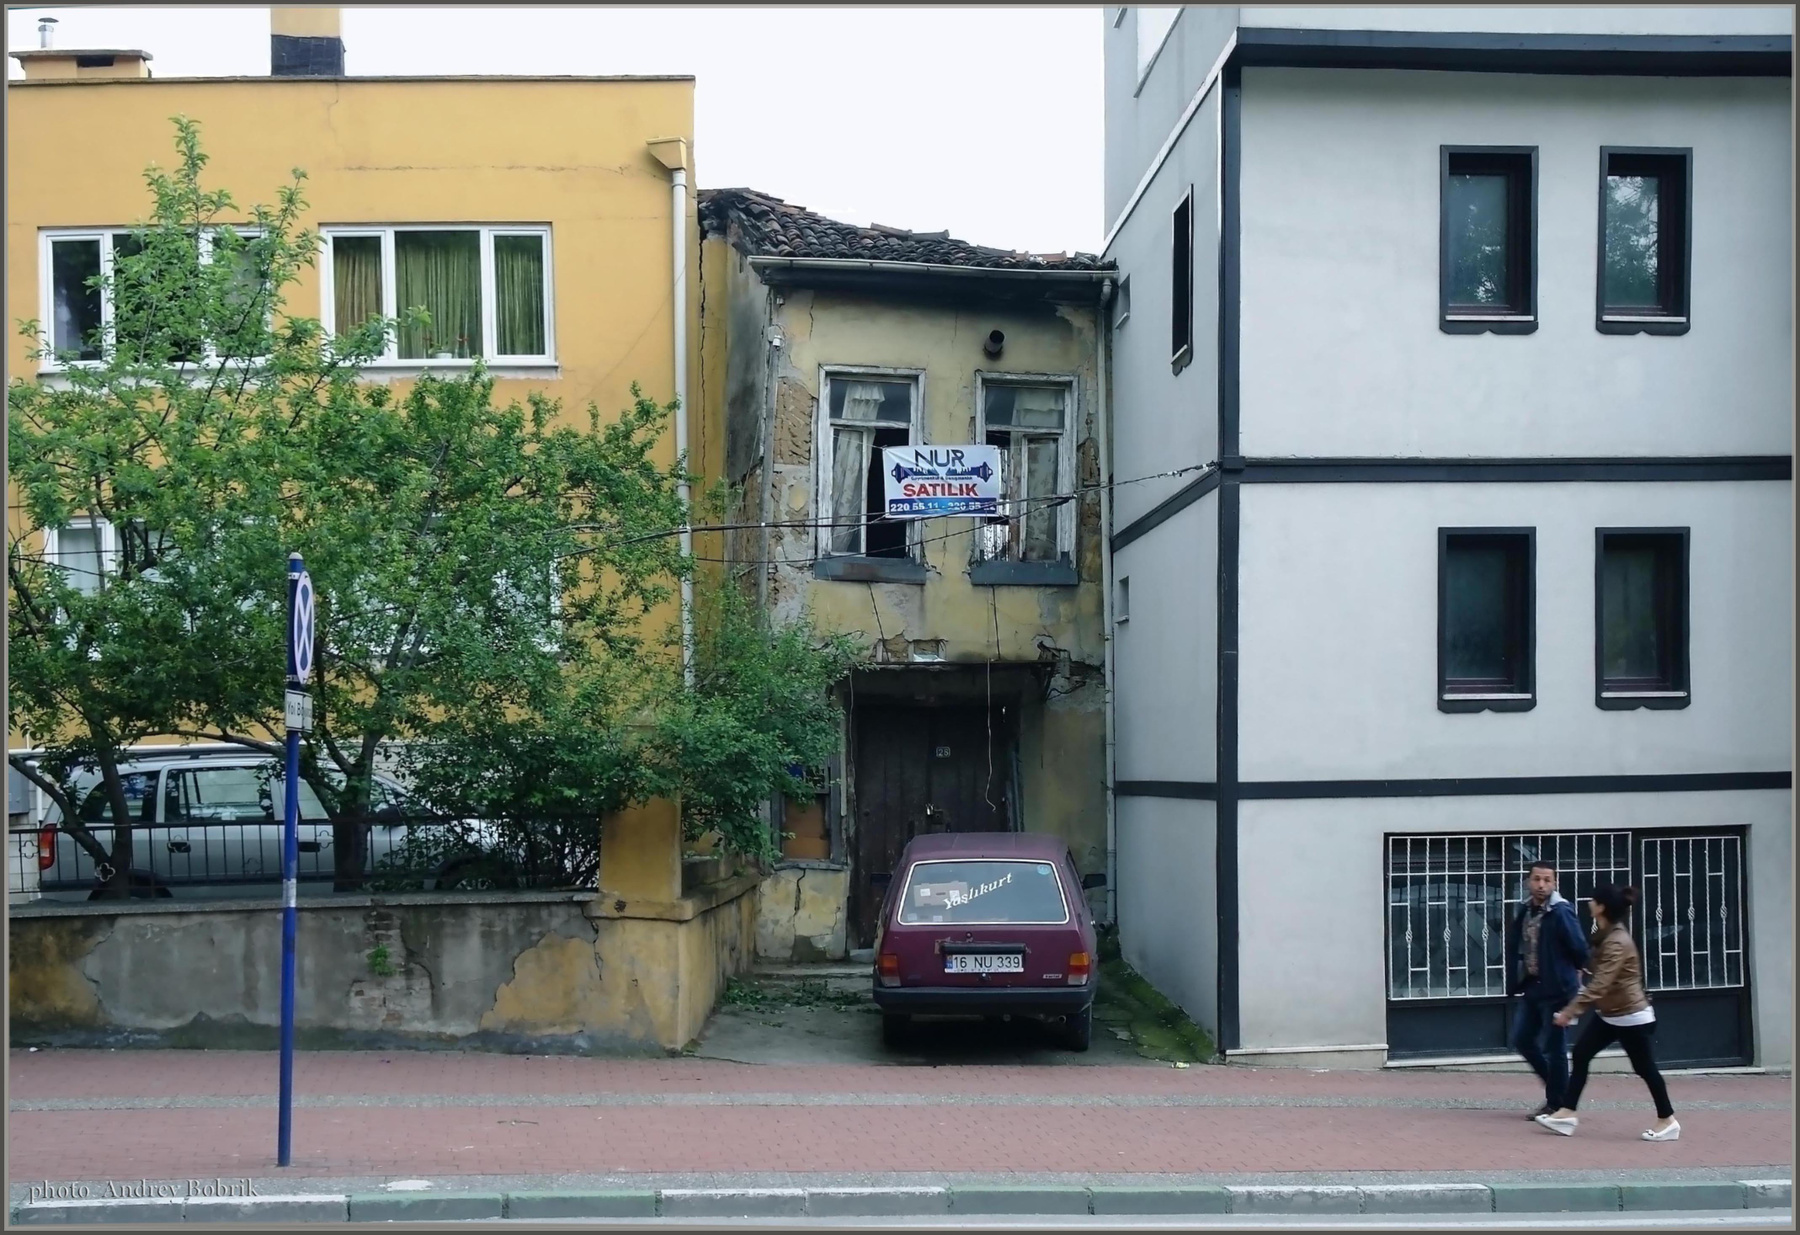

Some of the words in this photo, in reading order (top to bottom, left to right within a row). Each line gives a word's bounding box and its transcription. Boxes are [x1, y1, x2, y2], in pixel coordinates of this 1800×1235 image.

[914, 449, 965, 467] NUR
[903, 483, 979, 497] SATILIK
[890, 504, 910, 512] 220
[912, 503, 926, 511] 55
[944, 872, 1013, 910] Yaşlıkurt
[954, 956, 967, 969] 16
[974, 956, 993, 969] NU
[997, 956, 1020, 969] 339
